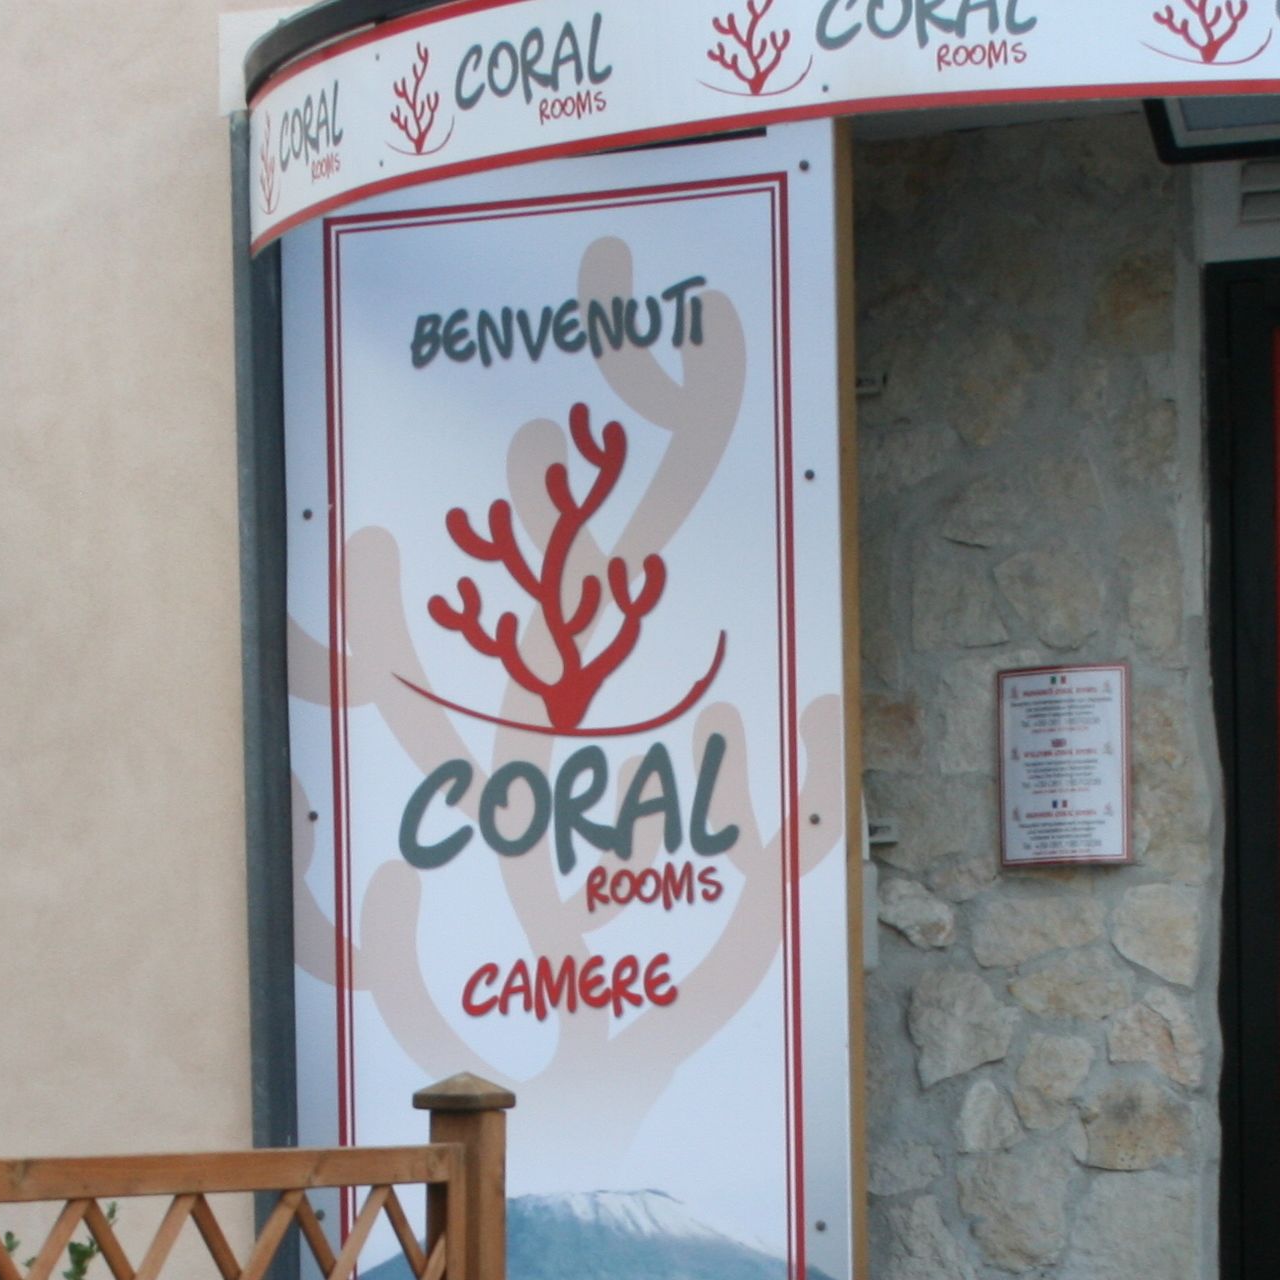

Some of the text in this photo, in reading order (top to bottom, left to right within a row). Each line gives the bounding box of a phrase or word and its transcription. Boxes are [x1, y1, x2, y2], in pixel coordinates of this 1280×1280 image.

[455, 12, 613, 111] CORAL
[936, 40, 1027, 72] ROOMS
[280, 80, 343, 173] CORAL
[539, 90, 607, 125] ROOMS
[410, 275, 708, 369] BENVENUTI
[398, 732, 740, 876] CORAL
[585, 861, 724, 913] ROOMS
[461, 952, 679, 1022] CAMERE
